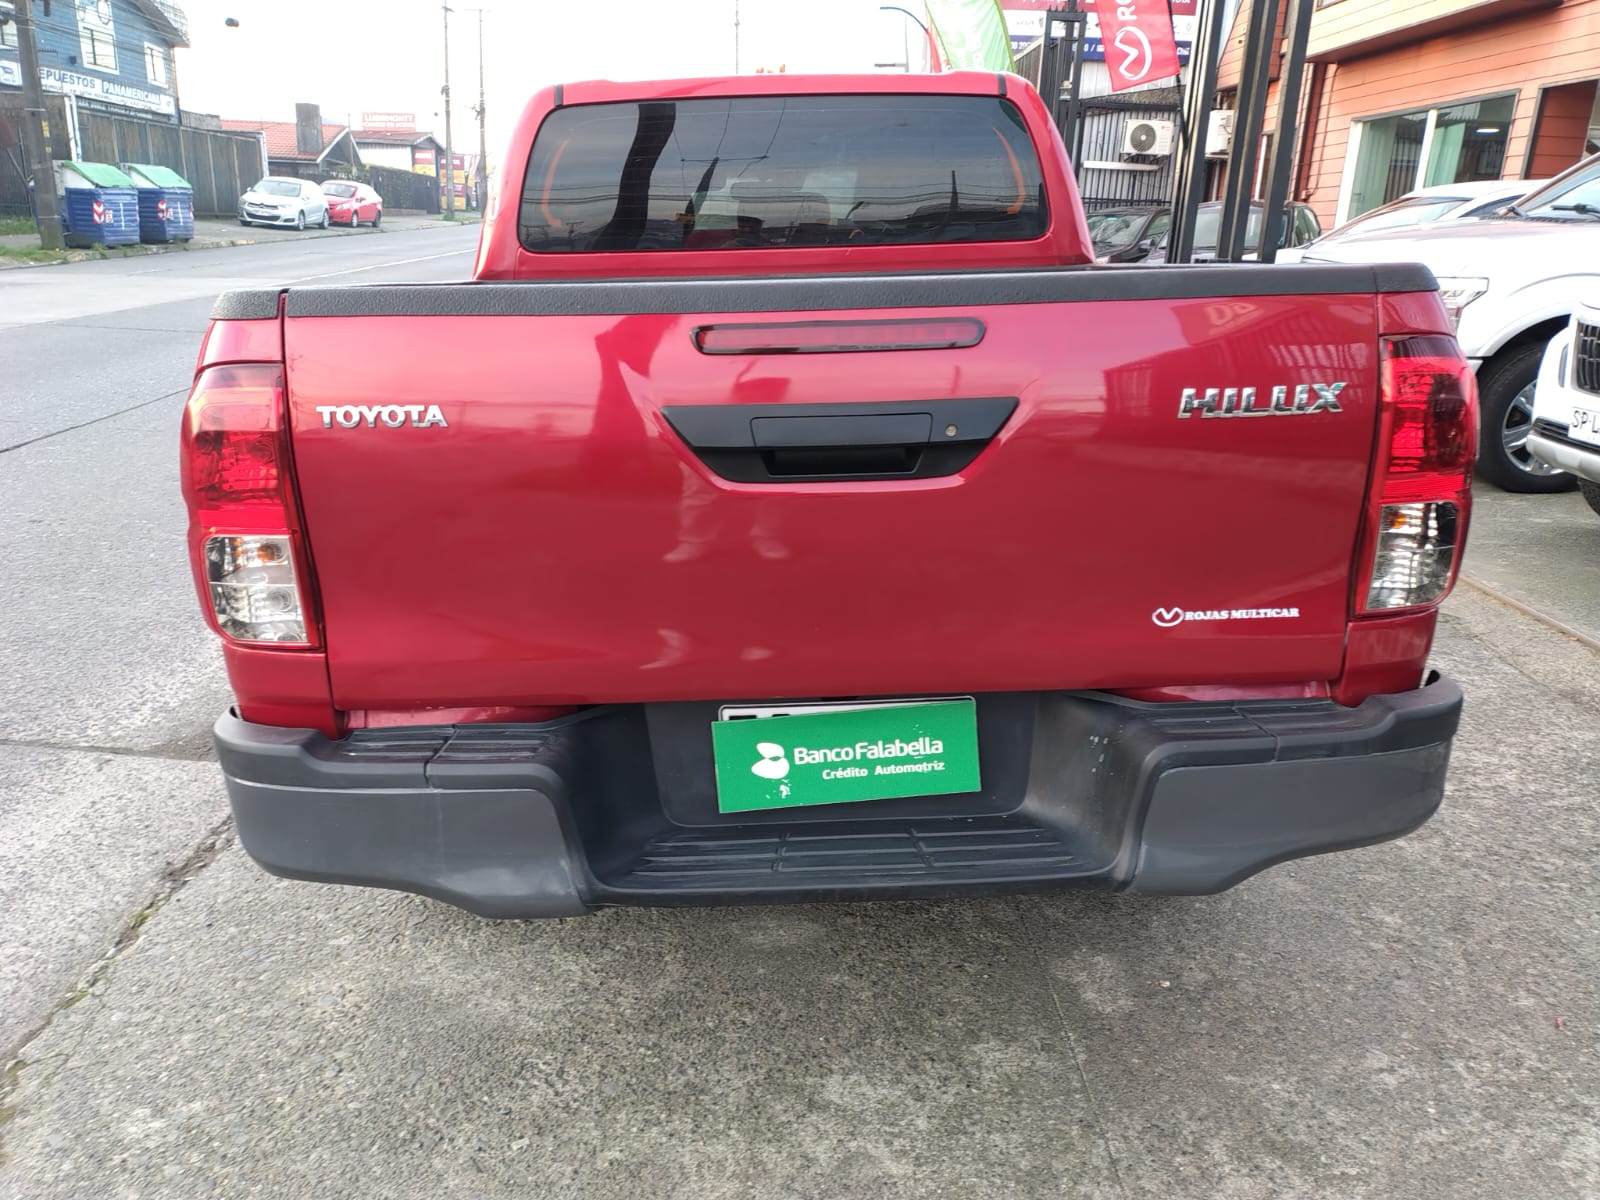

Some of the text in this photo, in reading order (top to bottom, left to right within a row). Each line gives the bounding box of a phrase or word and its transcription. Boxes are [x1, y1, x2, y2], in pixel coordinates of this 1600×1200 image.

[39, 69, 96, 89] EPUESTOS
[1177, 382, 1348, 419] HILUX
[315, 404, 448, 429] TOYOTA
[1184, 607, 1300, 621] ROJAS MULTICAR
[822, 760, 945, 780] Crédito Automotriz
